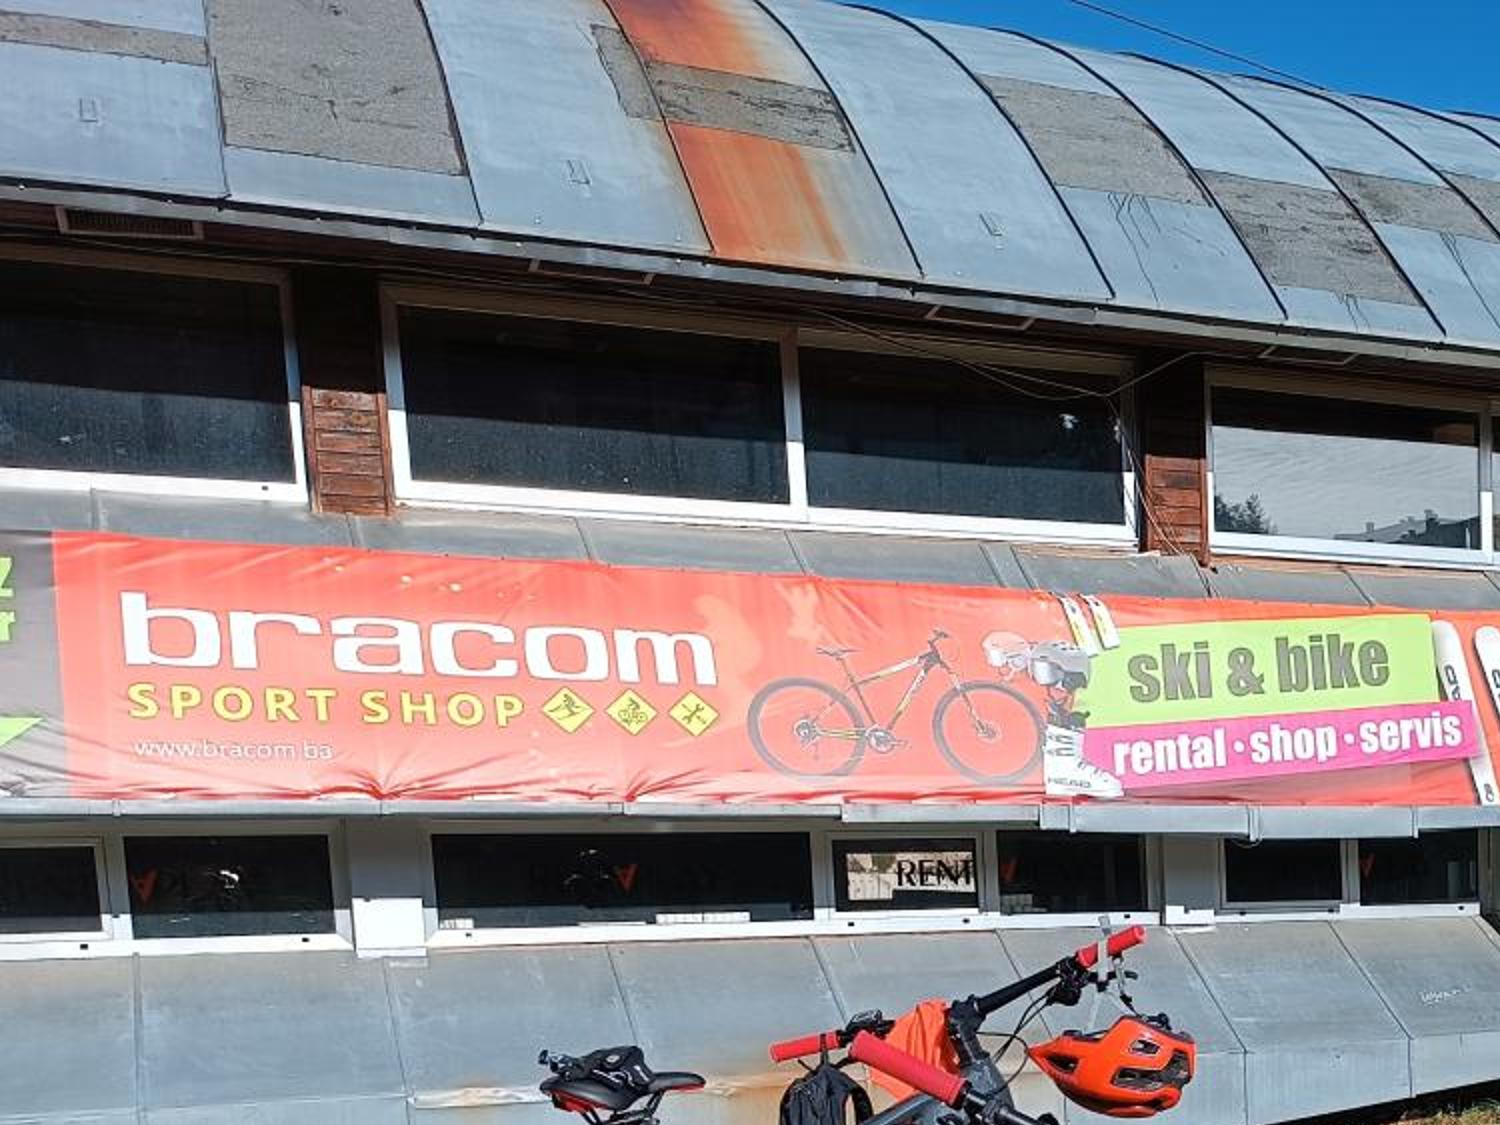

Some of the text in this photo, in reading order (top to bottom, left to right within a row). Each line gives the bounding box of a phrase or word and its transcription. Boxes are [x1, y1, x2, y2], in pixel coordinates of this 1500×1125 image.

[119, 592, 719, 687] bracom
[1127, 634, 1391, 703] ski & bike
[127, 682, 525, 729] SPORT SHOP
[133, 739, 334, 761] www.bracomba
[1113, 712, 1463, 777] rental shop servis
